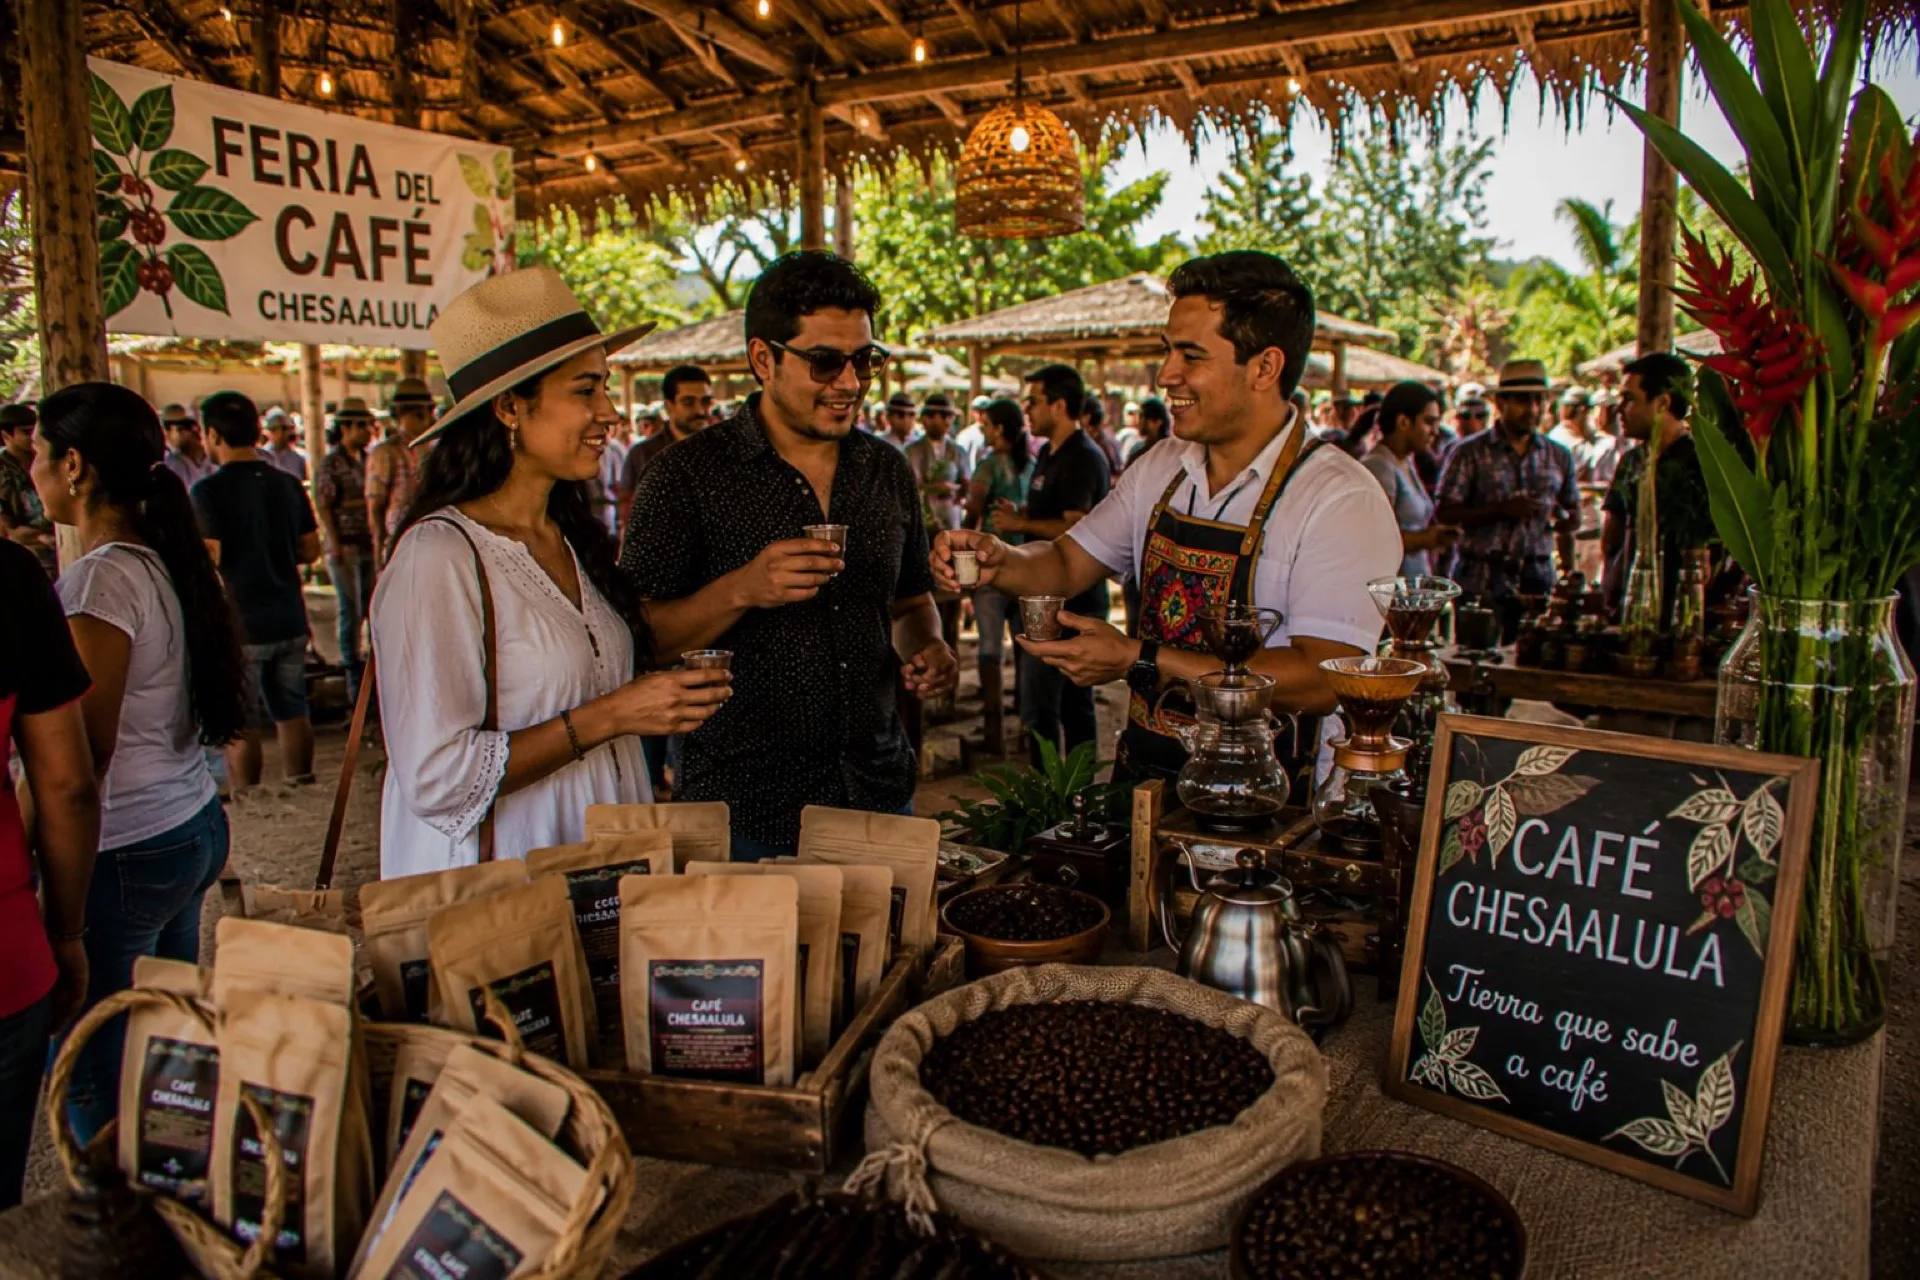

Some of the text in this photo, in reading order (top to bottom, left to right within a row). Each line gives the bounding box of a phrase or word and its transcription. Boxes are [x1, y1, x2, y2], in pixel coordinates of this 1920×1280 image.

[211, 115, 441, 205] FERIA DEL
[274, 204, 434, 286] CAFÉ
[258, 290, 439, 330] CHESAALULA
[1512, 818, 1660, 900] CAFÉ
[1447, 880, 1725, 988] CHESAALULA
[667, 1013, 745, 1026] CHESAALULA
[691, 998, 722, 1011] CAFÉ
[1447, 964, 1700, 1067] Tierra que sabe
[1506, 1054, 1609, 1112] a café
